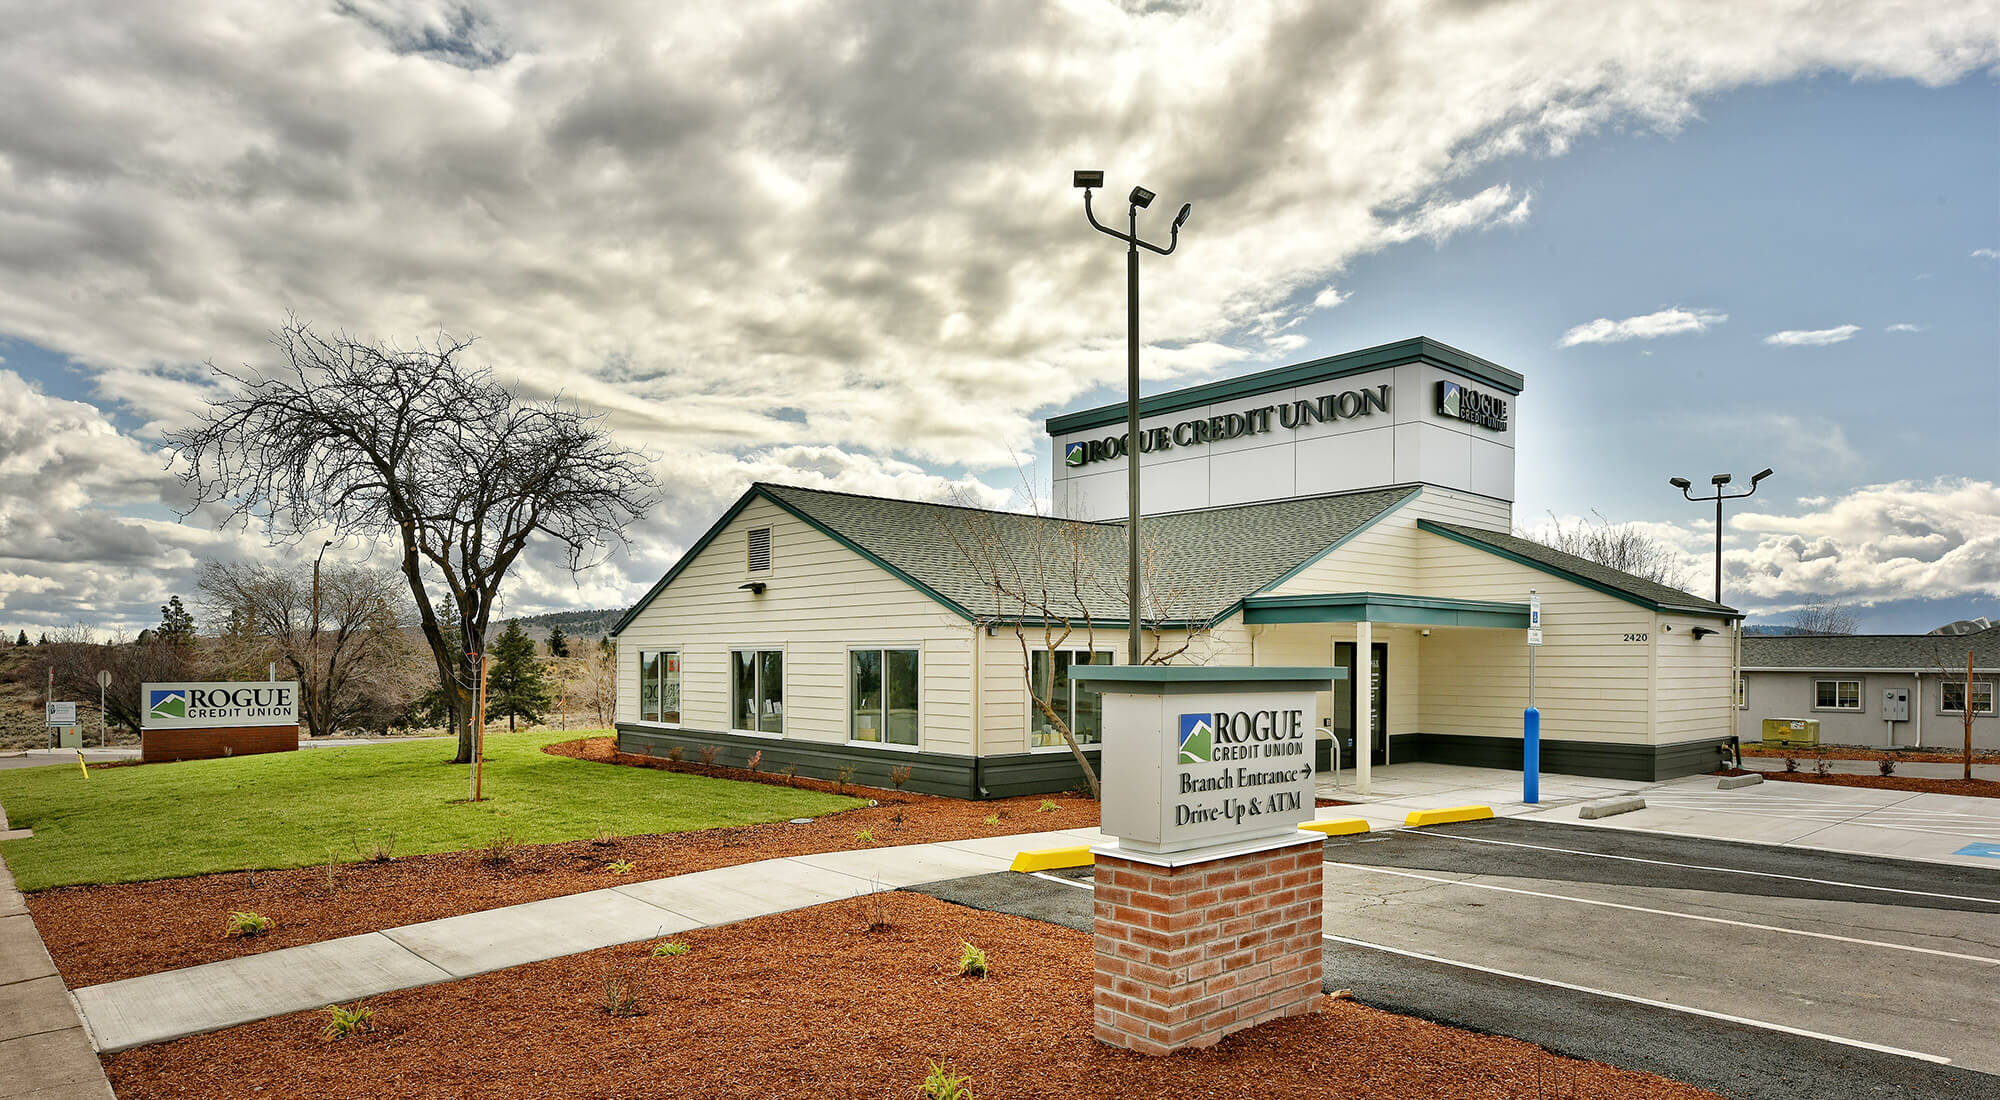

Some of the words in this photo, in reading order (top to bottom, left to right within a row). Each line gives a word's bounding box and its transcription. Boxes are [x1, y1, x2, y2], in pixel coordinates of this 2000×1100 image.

[1173, 405, 1275, 447] CREDIT
[1278, 384, 1389, 429] UNION
[1460, 386, 1508, 421] ROGUE
[1460, 408, 1486, 425] CREDIT
[1623, 633, 1648, 642] 2420
[188, 688, 293, 709] ROGUE
[188, 708, 241, 719] CREDIT
[247, 707, 291, 717] UNION
[1213, 710, 1304, 744] ROGUE
[1212, 744, 1260, 762] CREDIT
[1264, 742, 1303, 758] UNION
[1180, 768, 1234, 794] Branch
[1237, 767, 1298, 788] Entrance
[1175, 798, 1246, 827] Drive-Up
[1249, 797, 1263, 817] &
[1266, 791, 1302, 814] ATM
